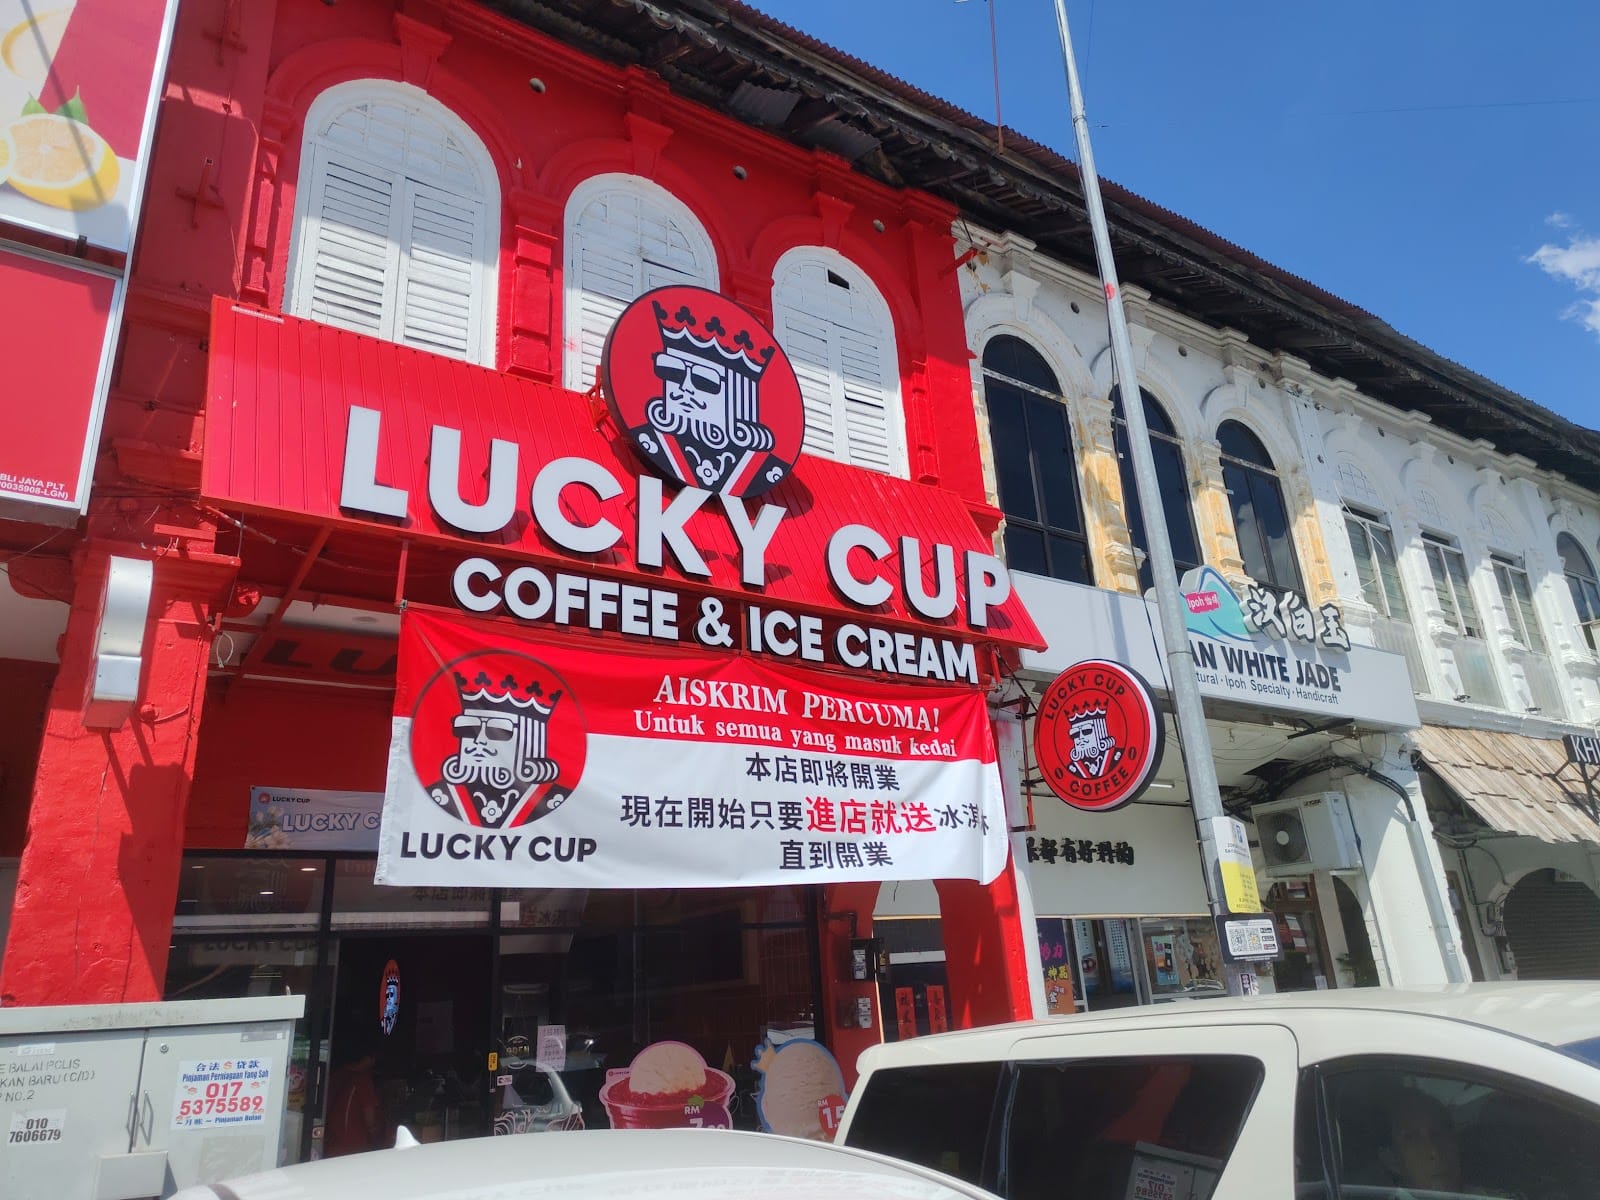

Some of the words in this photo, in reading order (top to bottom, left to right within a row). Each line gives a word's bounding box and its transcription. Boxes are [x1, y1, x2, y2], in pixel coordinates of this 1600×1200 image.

[19, 477, 44, 488] JAYA
[46, 481, 65, 491] PLT
[340, 405, 788, 587] LUCKY
[826, 524, 1011, 627] CUP
[1187, 596, 1205, 610] Ipoh
[453, 557, 679, 640] COFFEE
[698, 597, 734, 647] &
[749, 606, 824, 662] ICE
[836, 623, 979, 684] CREAM
[1221, 646, 1290, 683] WHITE
[1296, 660, 1341, 692] JADE
[653, 675, 788, 715] AISKRIM
[801, 691, 941, 733] PERCUMA!
[1044, 674, 1087, 720] LUCKY
[1093, 674, 1126, 696] CUP
[1225, 674, 1246, 690] Ipoh
[1250, 678, 1290, 699] Specialty
[1296, 687, 1340, 705] Handicraft
[634, 710, 705, 735] Untuk
[716, 720, 782, 742] semua
[791, 728, 836, 753] yang
[845, 735, 902, 756] masuk
[910, 737, 957, 757] kedai
[745, 752, 901, 791] 本店即將開業
[1069, 766, 1129, 797] COFFEE
[281, 812, 361, 832] LUCKY
[400, 831, 522, 861] LUCKY
[528, 836, 597, 862] CUP
[779, 840, 893, 870] 直到開業
[182, 1072, 209, 1082] Pinjaman
[205, 1081, 243, 1098] 017
[180, 1095, 263, 1116] 5375589
[684, 1105, 701, 1115] RM
[9, 1129, 61, 1143] 7606679
[26, 1118, 48, 1129] 010
